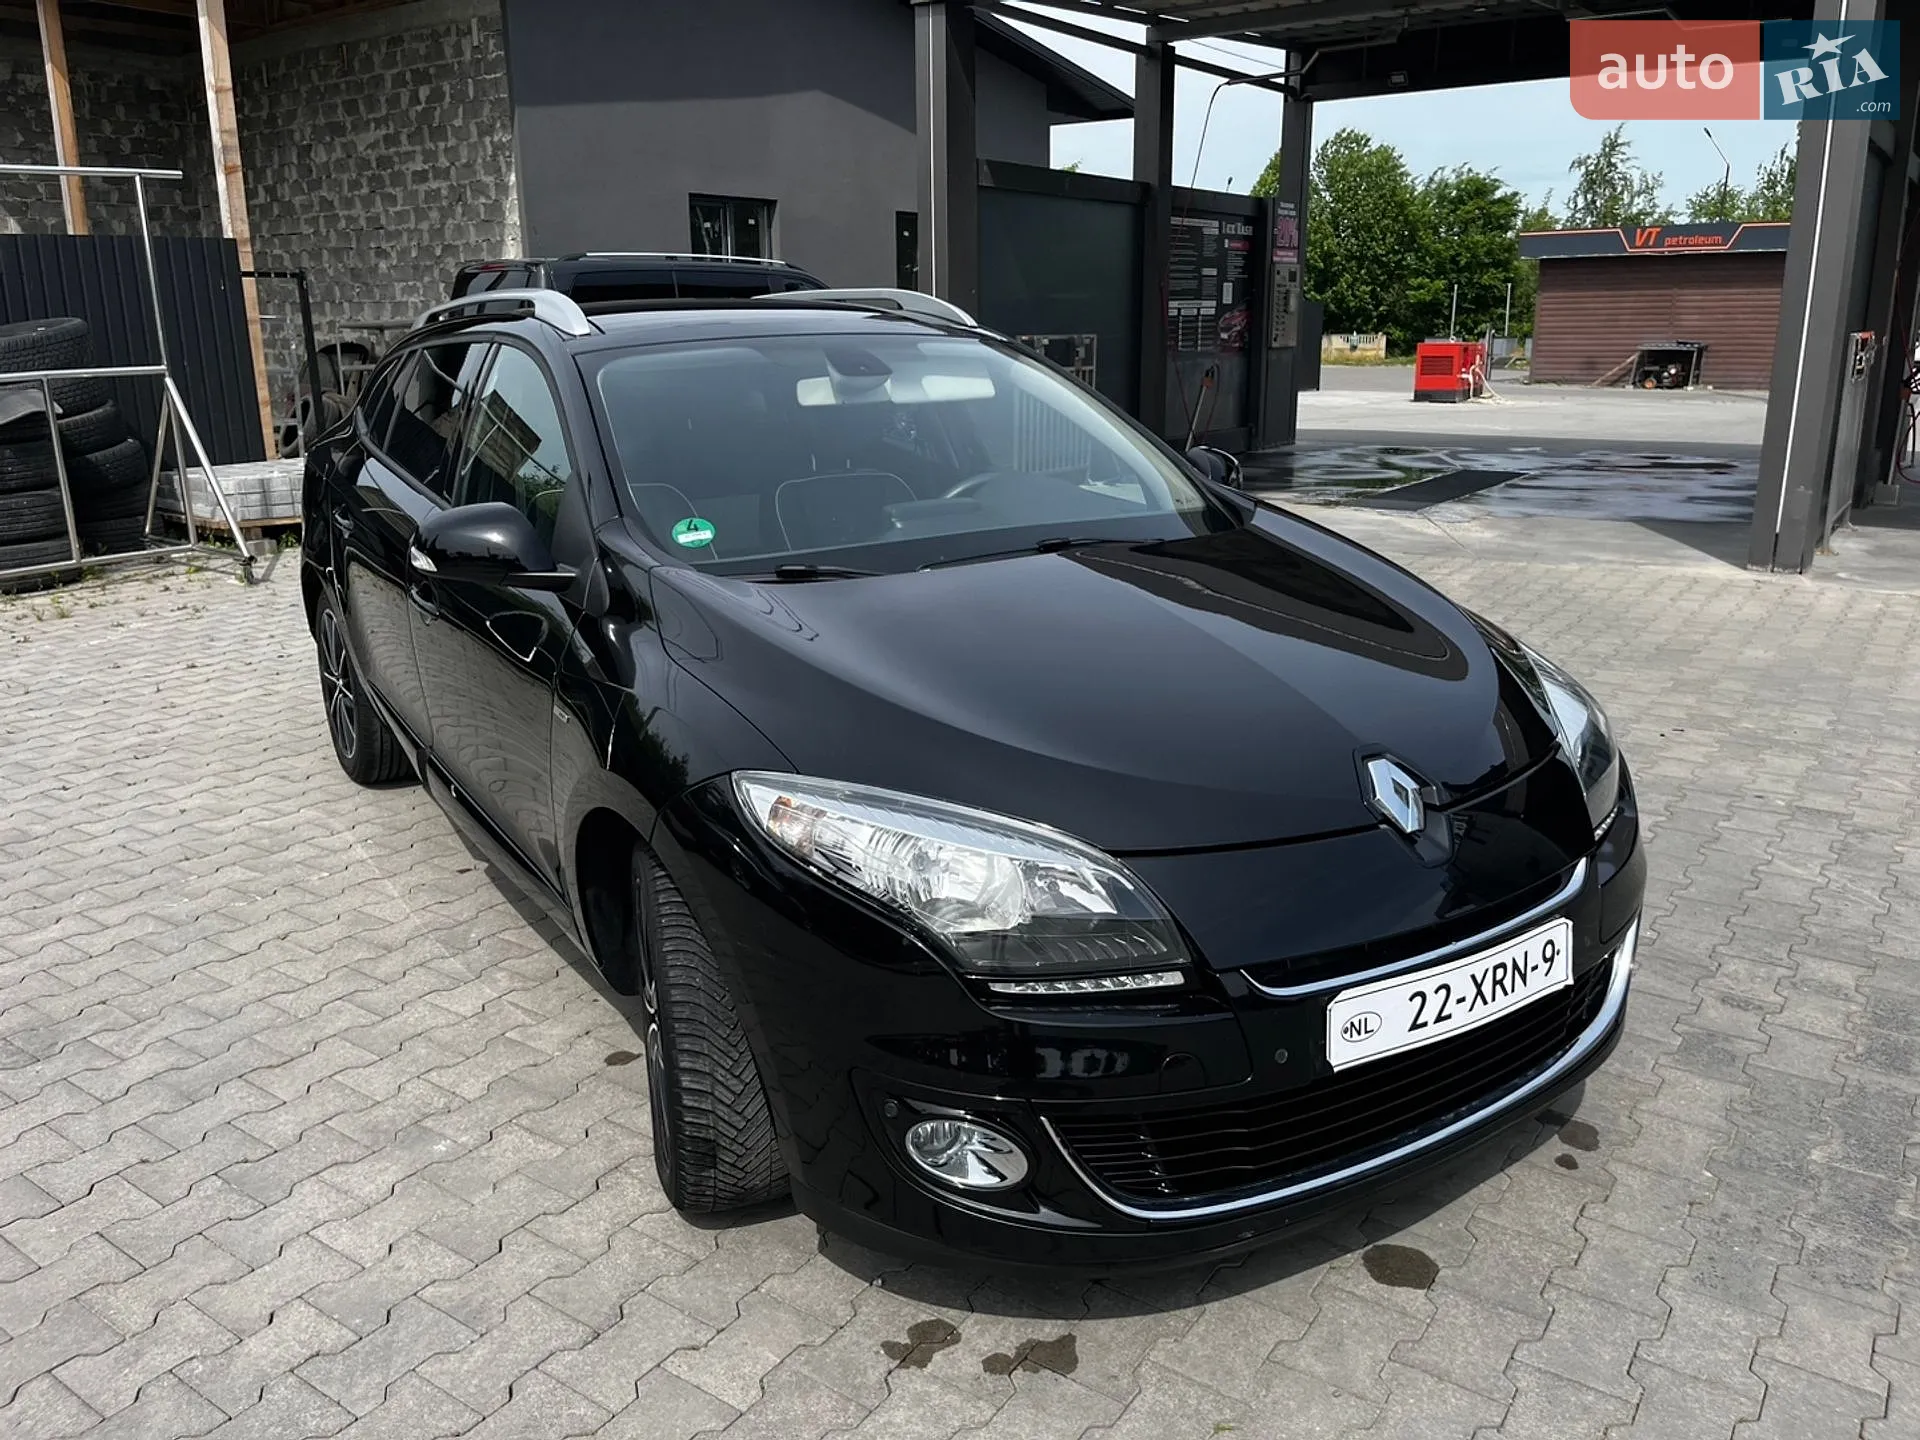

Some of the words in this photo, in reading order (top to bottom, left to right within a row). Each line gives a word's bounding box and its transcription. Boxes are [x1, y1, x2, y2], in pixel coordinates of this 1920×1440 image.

[1635, 227, 1662, 247] VT
[1664, 235, 1723, 247] petroleum
[687, 519, 698, 531] 4
[1349, 1018, 1375, 1039] NL
[1407, 938, 1557, 1033] 22-XRN-9
